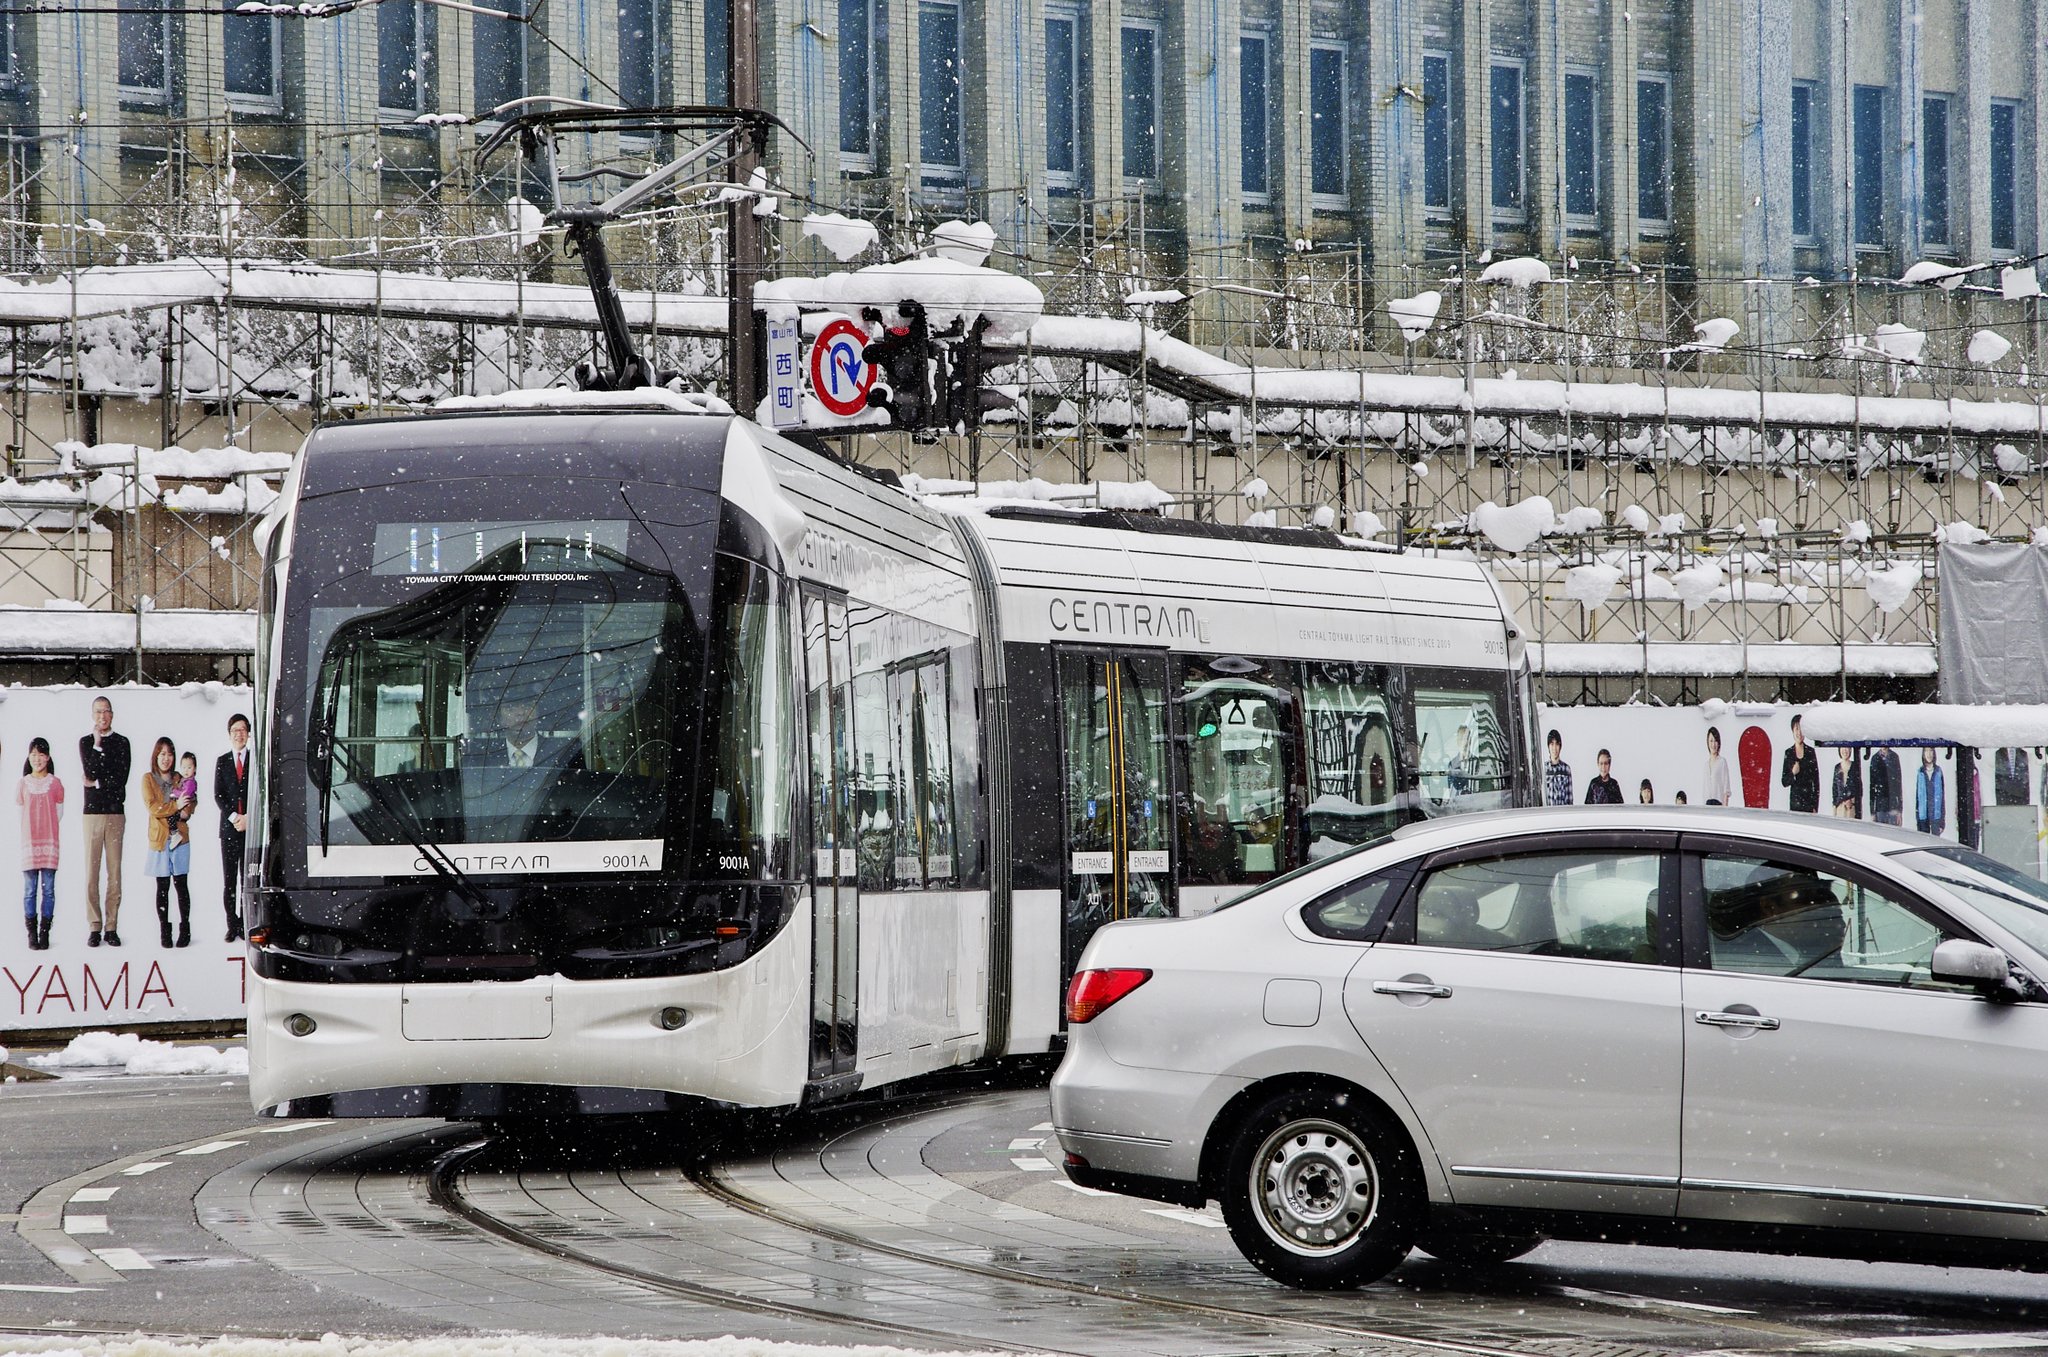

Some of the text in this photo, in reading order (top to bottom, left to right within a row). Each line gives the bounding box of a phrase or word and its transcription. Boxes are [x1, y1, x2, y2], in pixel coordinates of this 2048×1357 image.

[776, 353, 793, 408] 西町
[406, 576, 438, 584] TOYAMA
[440, 575, 458, 583] CITY
[464, 574, 497, 582] TOYAMA
[531, 573, 576, 581] TETSUDOU,
[1050, 598, 1196, 638] CENTRAM
[1299, 630, 1326, 641] CENTRAL
[1328, 631, 1353, 643] TOYAMA
[1355, 634, 1373, 645] LIGHT
[1376, 635, 1389, 646] RAIL
[1391, 636, 1415, 647] TRANSIT
[1418, 638, 1435, 648] SINCE
[1484, 640, 1504, 655] 9001B
[602, 855, 650, 868] 9001A
[719, 856, 750, 869] 9001A
[1078, 858, 1108, 869] ENTRANCE
[1134, 856, 1164, 868] ENTRANCE
[2, 960, 175, 1015] YAMA
